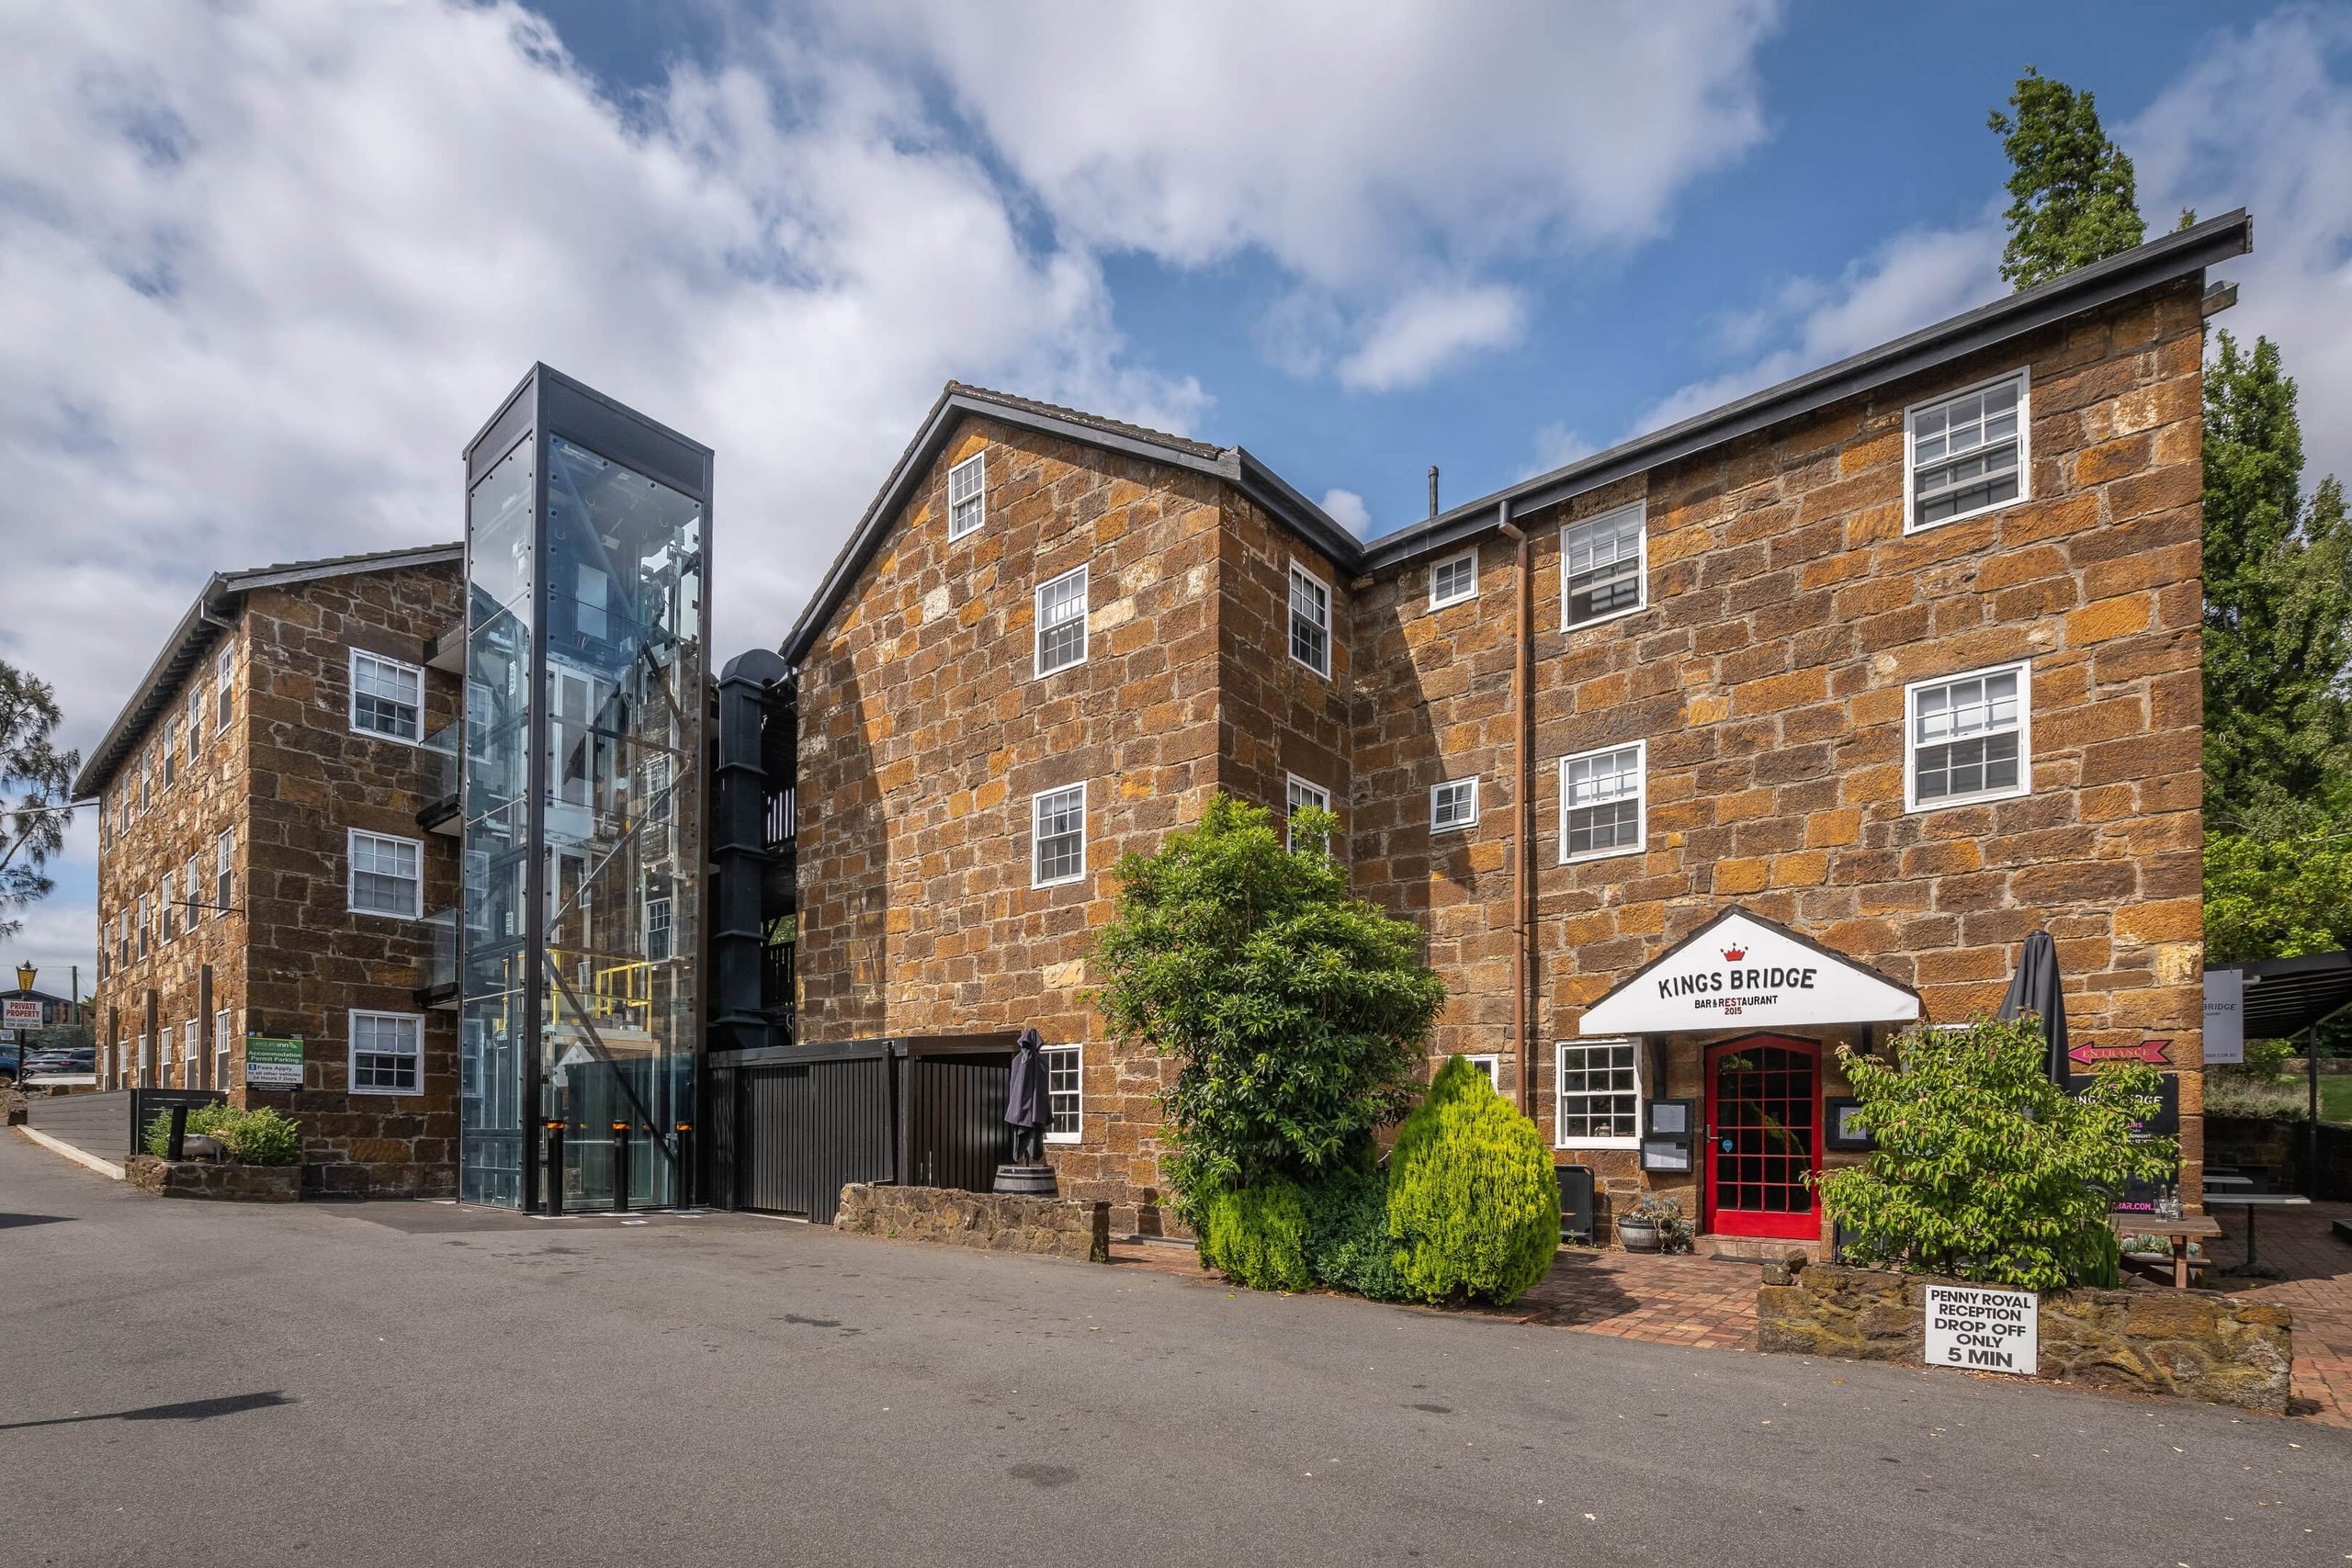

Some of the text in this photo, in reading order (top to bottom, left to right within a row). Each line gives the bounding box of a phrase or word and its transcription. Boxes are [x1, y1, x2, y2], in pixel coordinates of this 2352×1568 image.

[1658, 967, 1817, 999] KINGS BRIDGE
[1724, 1007, 1743, 1015] 2015
[2083, 1048, 2150, 1057] ENTRANCE
[1931, 1290, 2031, 1309] PENNY ROYAL
[1939, 1303, 2021, 1322] RECEPTION
[1935, 1318, 2026, 1337] DROP OFF
[1956, 1334, 2004, 1348] ONLY
[1948, 1347, 2013, 1368] 5 MIN
